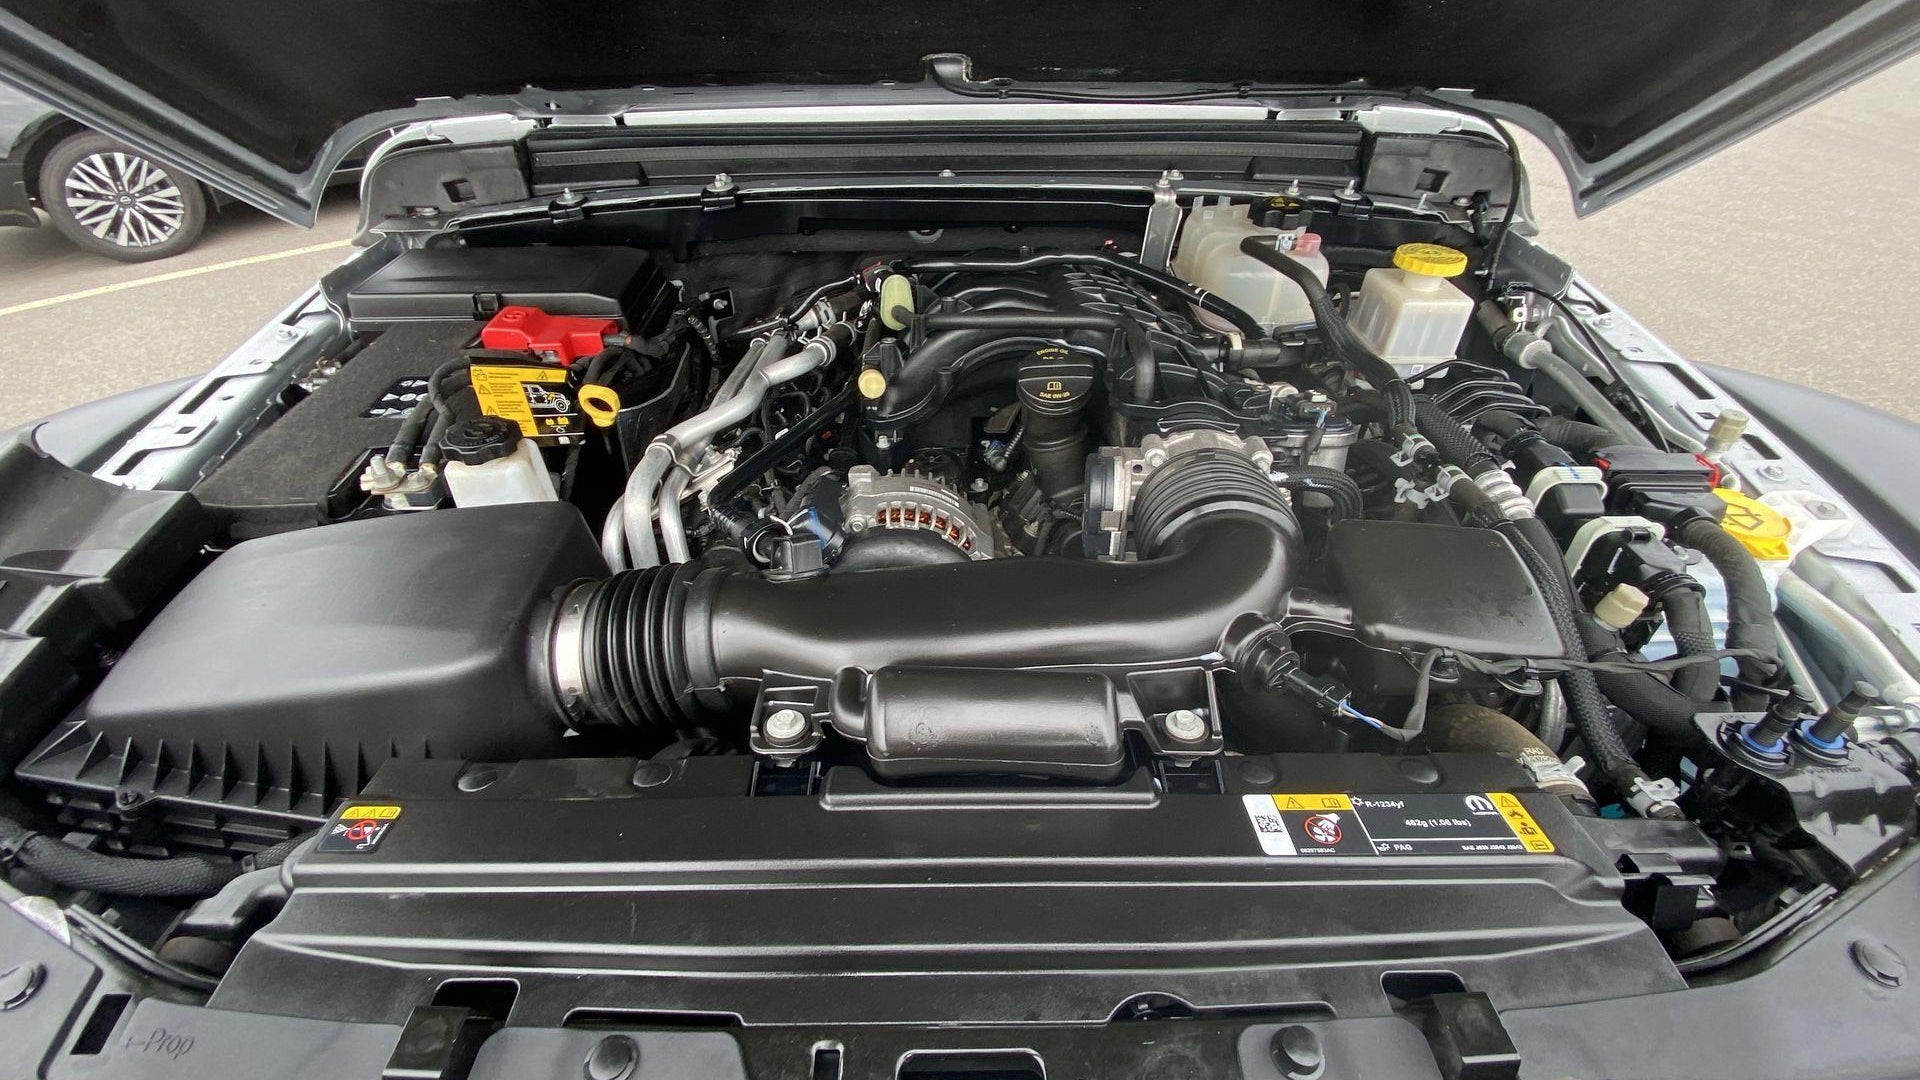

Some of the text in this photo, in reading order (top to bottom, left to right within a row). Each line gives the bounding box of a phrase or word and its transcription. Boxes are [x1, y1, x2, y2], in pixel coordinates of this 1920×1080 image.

[1036, 347, 1059, 355] ENGINE
[1364, 800, 1405, 809] R-1234yf
[1452, 819, 1472, 828] lbs)
[143, 1027, 195, 1061] Prop
